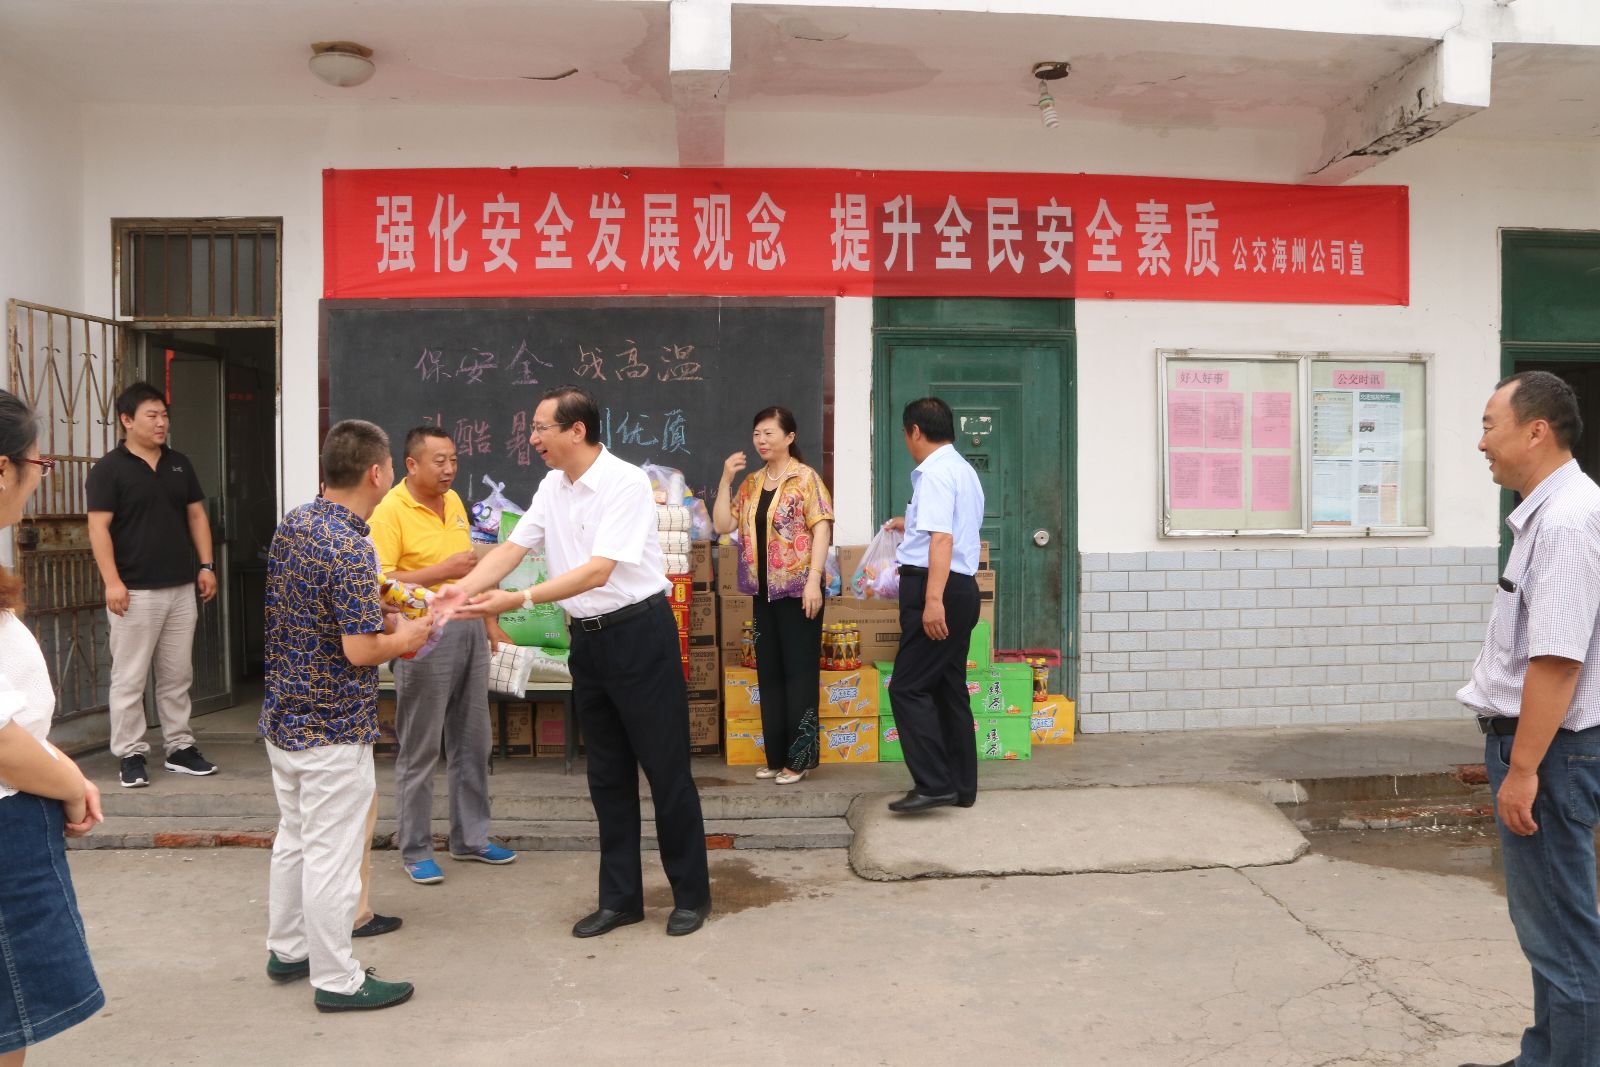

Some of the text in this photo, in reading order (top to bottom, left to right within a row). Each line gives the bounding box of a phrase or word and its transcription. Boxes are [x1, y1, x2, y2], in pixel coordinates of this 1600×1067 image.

[375, 191, 1221, 278] 强化安全发展观念 提升全民安全素质
[1232, 236, 1365, 276] 公交海州公司宣
[1180, 372, 1224, 385] 好人好事
[1337, 373, 1381, 385] 公交时讯
